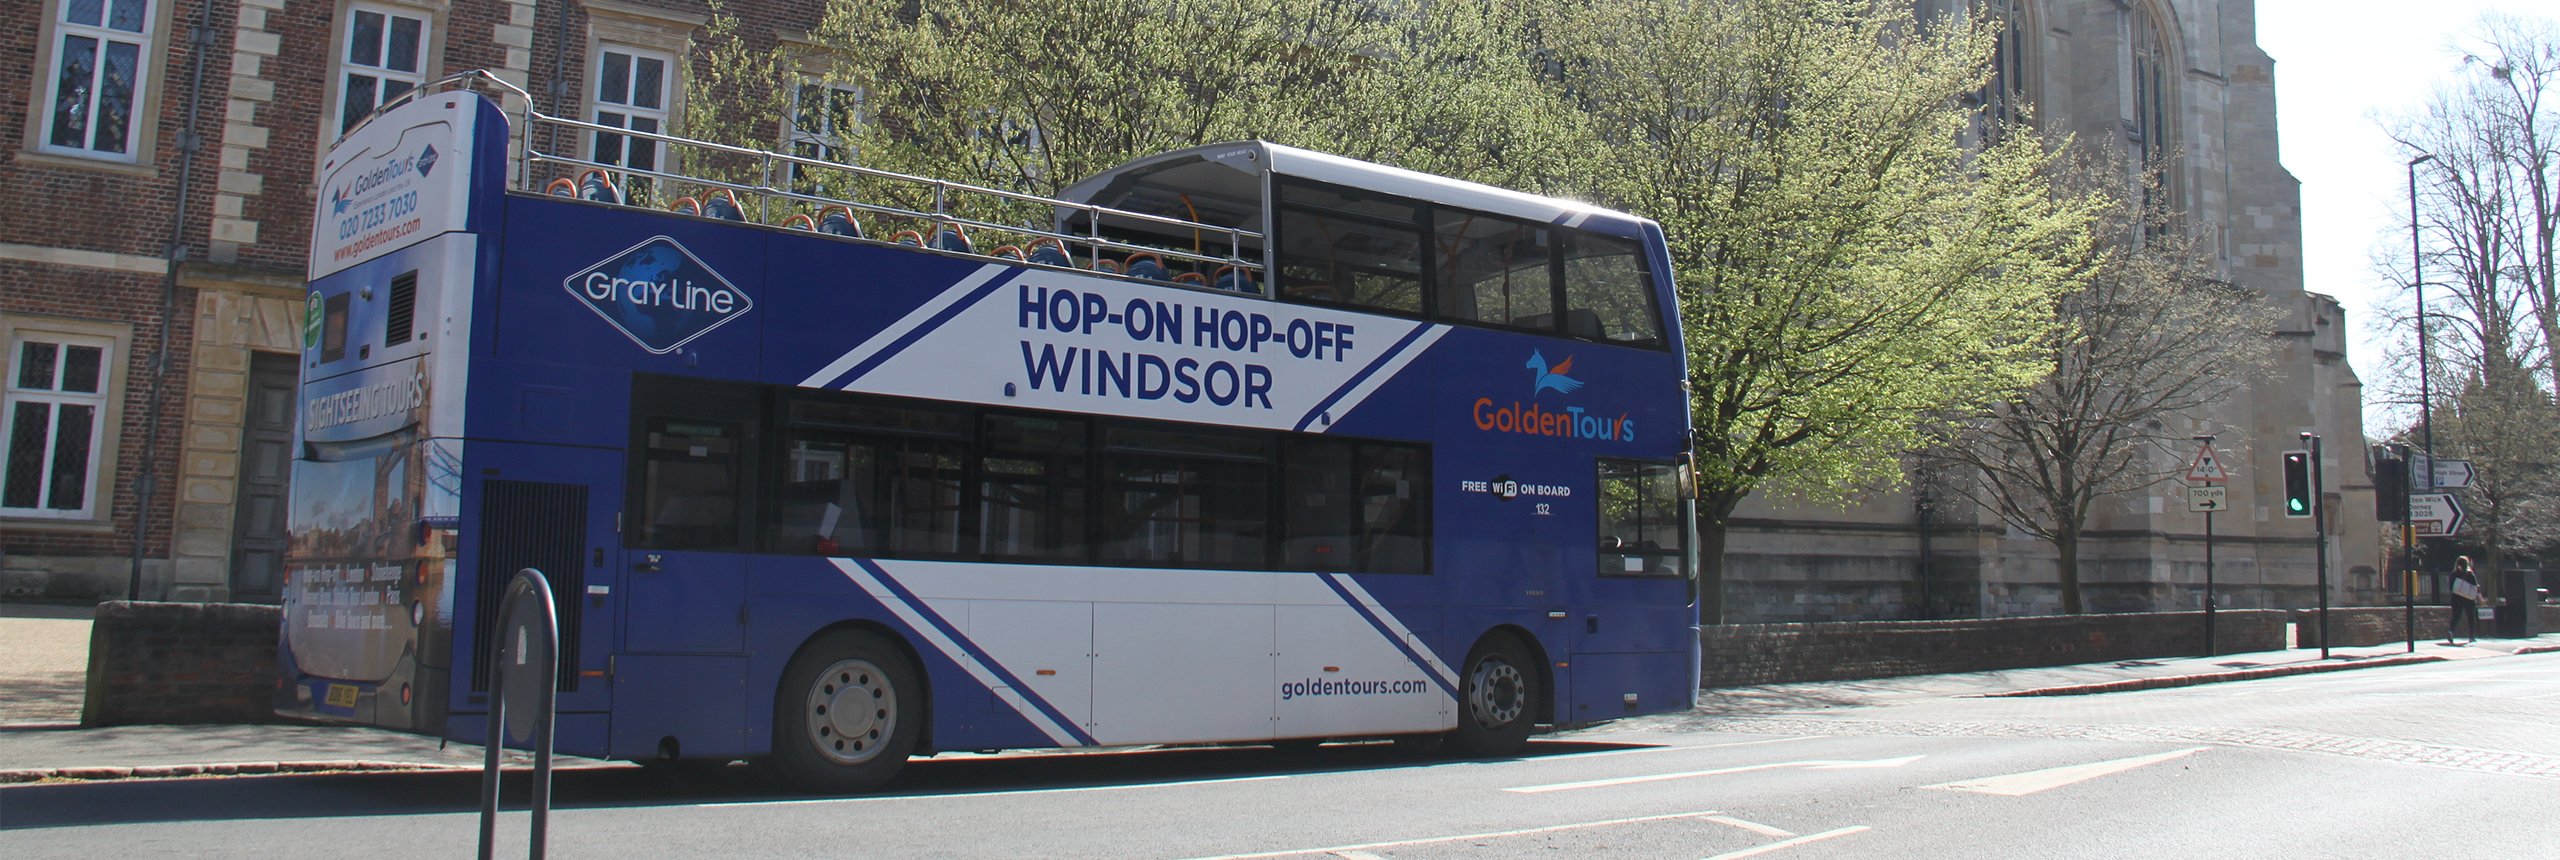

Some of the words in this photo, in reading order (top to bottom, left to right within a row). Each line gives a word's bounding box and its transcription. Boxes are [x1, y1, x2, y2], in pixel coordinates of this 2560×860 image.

[355, 151, 414, 196] GoldenTours
[340, 214, 359, 241] 020
[361, 202, 386, 231] 7233
[389, 190, 417, 220] 7030
[334, 217, 421, 261] www.goldentours.com
[586, 272, 666, 306] Gray
[672, 278, 734, 314] Line
[1018, 284, 1182, 345] HOP-ON
[1194, 306, 1354, 362] HOP-OFF
[1020, 340, 1273, 410] WINDSOR
[308, 385, 381, 432] SIGHTSEEING
[381, 372, 424, 417] TOURS
[1473, 397, 1634, 442] GoldenTours
[1462, 480, 1487, 493] FREE
[1492, 480, 1518, 497] WiFi
[1520, 483, 1535, 495] ON
[1537, 484, 1570, 497] BOARD
[1535, 503, 1550, 515] 132
[1281, 677, 1427, 700] goldentours.com
